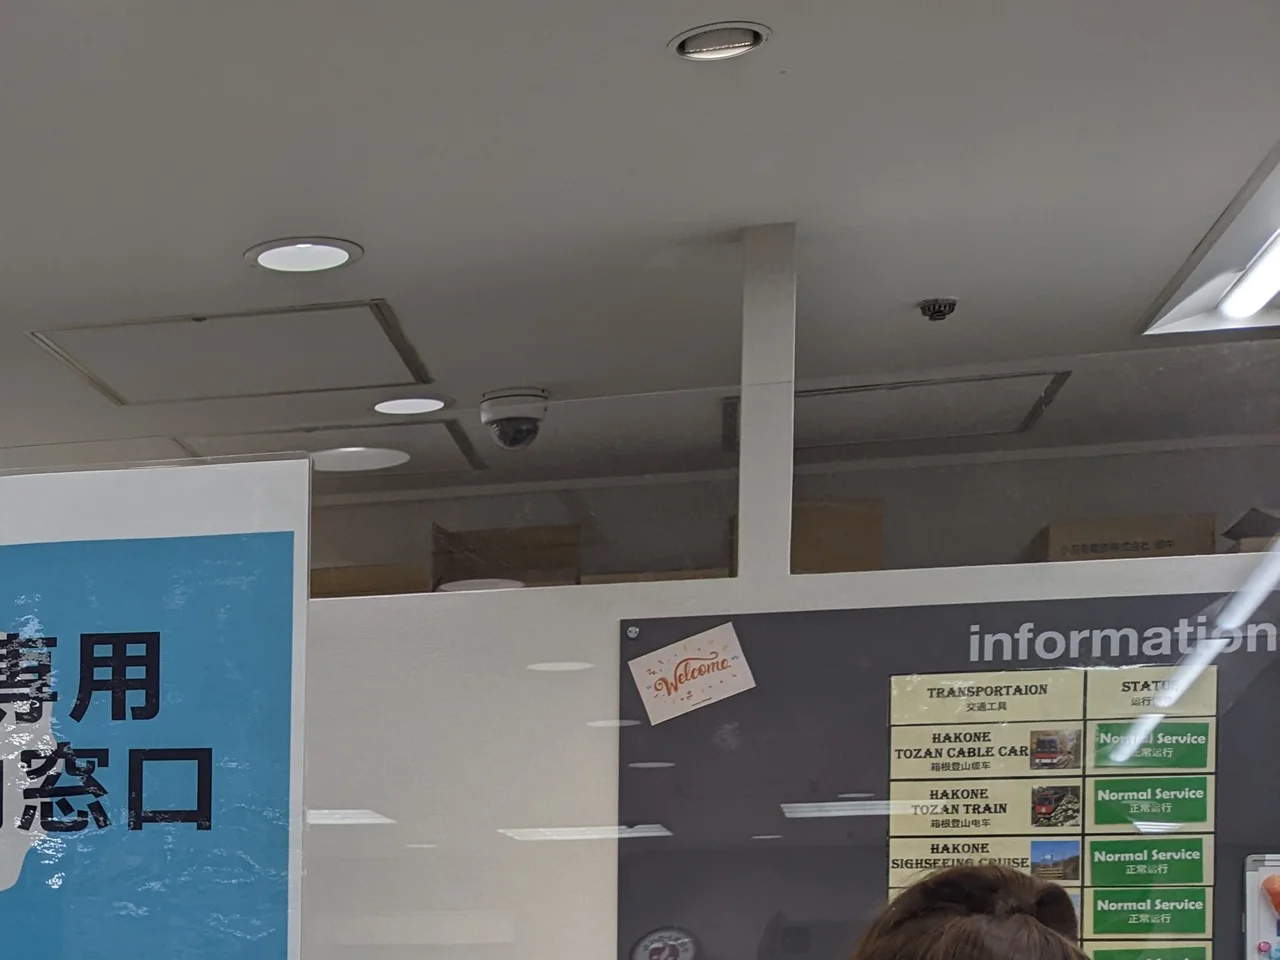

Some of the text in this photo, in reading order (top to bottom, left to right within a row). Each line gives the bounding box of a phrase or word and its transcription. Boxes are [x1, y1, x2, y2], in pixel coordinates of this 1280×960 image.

[970, 615, 1277, 662] information
[654, 651, 730, 697] Welcome
[927, 684, 1048, 699] TRANSPORTAION
[966, 702, 1007, 712] 交通工具
[932, 731, 991, 744] HAKONE
[1157, 732, 1206, 744] Service
[895, 745, 1029, 759] TOZAN CABLE CAR
[929, 788, 989, 800] HAKONE
[1098, 788, 1204, 800] Normal Service
[911, 803, 1008, 816] TOZAN TRAIN
[1129, 802, 1172, 813] 正常运行
[930, 819, 991, 829] 箱根登山电车
[930, 843, 990, 854] HAKONE
[1094, 849, 1200, 862] Normal Service
[1125, 864, 1168, 875] 正常运行
[1097, 899, 1203, 911] Normal Service
[1128, 914, 1171, 924] 正常运行
